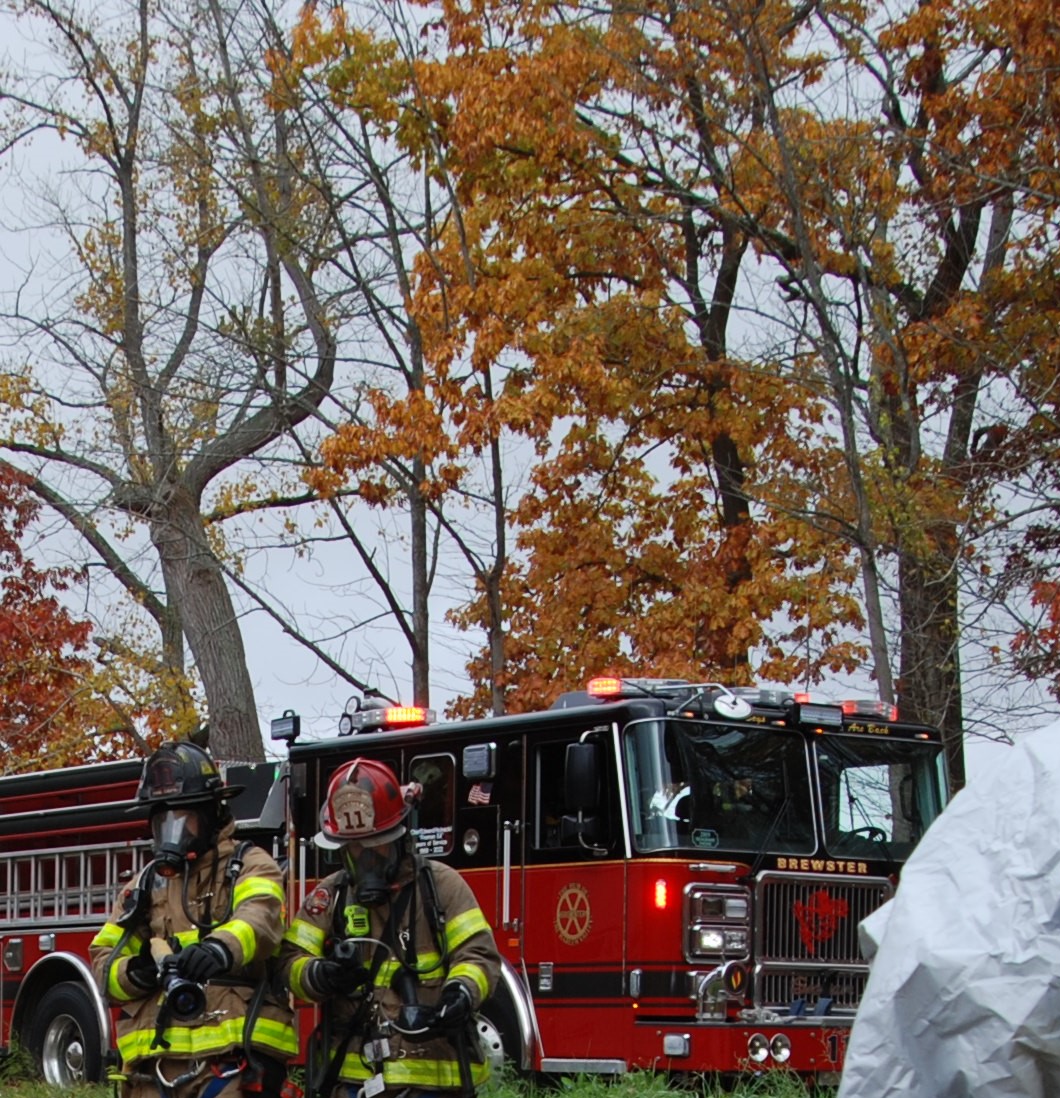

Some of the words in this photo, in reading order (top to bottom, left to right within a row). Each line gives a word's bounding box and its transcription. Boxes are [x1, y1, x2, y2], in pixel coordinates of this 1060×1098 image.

[848, 723, 865, 733] Are
[867, 723, 889, 735] Back
[343, 810, 366, 830] 11
[777, 857, 868, 874] BREWSTER
